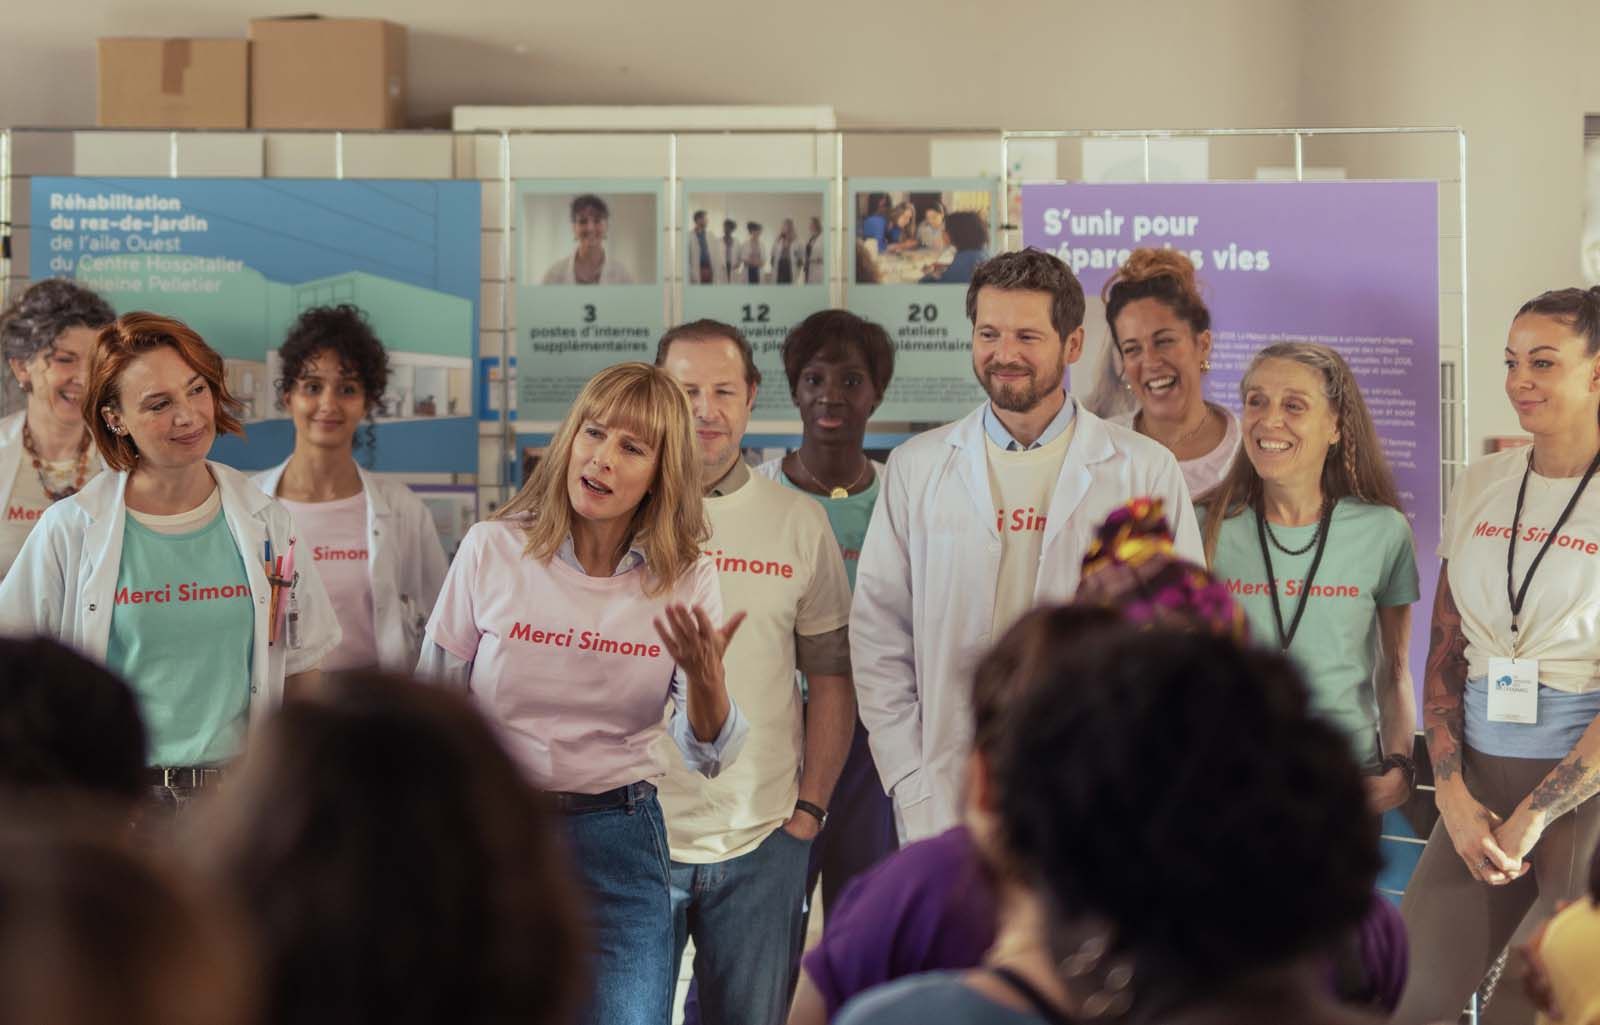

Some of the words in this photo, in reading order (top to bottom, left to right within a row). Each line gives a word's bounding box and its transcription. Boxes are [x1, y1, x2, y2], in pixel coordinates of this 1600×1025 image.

[50, 193, 181, 211] Réhabilitation
[50, 214, 75, 230] du
[80, 214, 208, 235] rez-de-jardin
[1043, 208, 1125, 236] S'unir
[1133, 214, 1199, 242] pour
[51, 236, 74, 251] de
[126, 235, 181, 252] Ouest
[51, 256, 74, 271] du
[79, 254, 141, 272] Centre
[146, 256, 245, 276] Hospitalier
[1213, 243, 1271, 271] vies
[583, 303, 597, 323] 3
[741, 303, 771, 323] 12
[908, 303, 938, 323] 20
[530, 327, 578, 339] postes
[898, 326, 948, 337] ateliers
[533, 340, 649, 355] supplémentaires
[8, 506, 45, 521] Mer
[312, 545, 369, 561] Simon
[704, 550, 793, 579] imone
[115, 584, 171, 605] Merci
[178, 582, 251, 601] Simon
[509, 622, 574, 647] Merci
[578, 631, 661, 657] Simone
